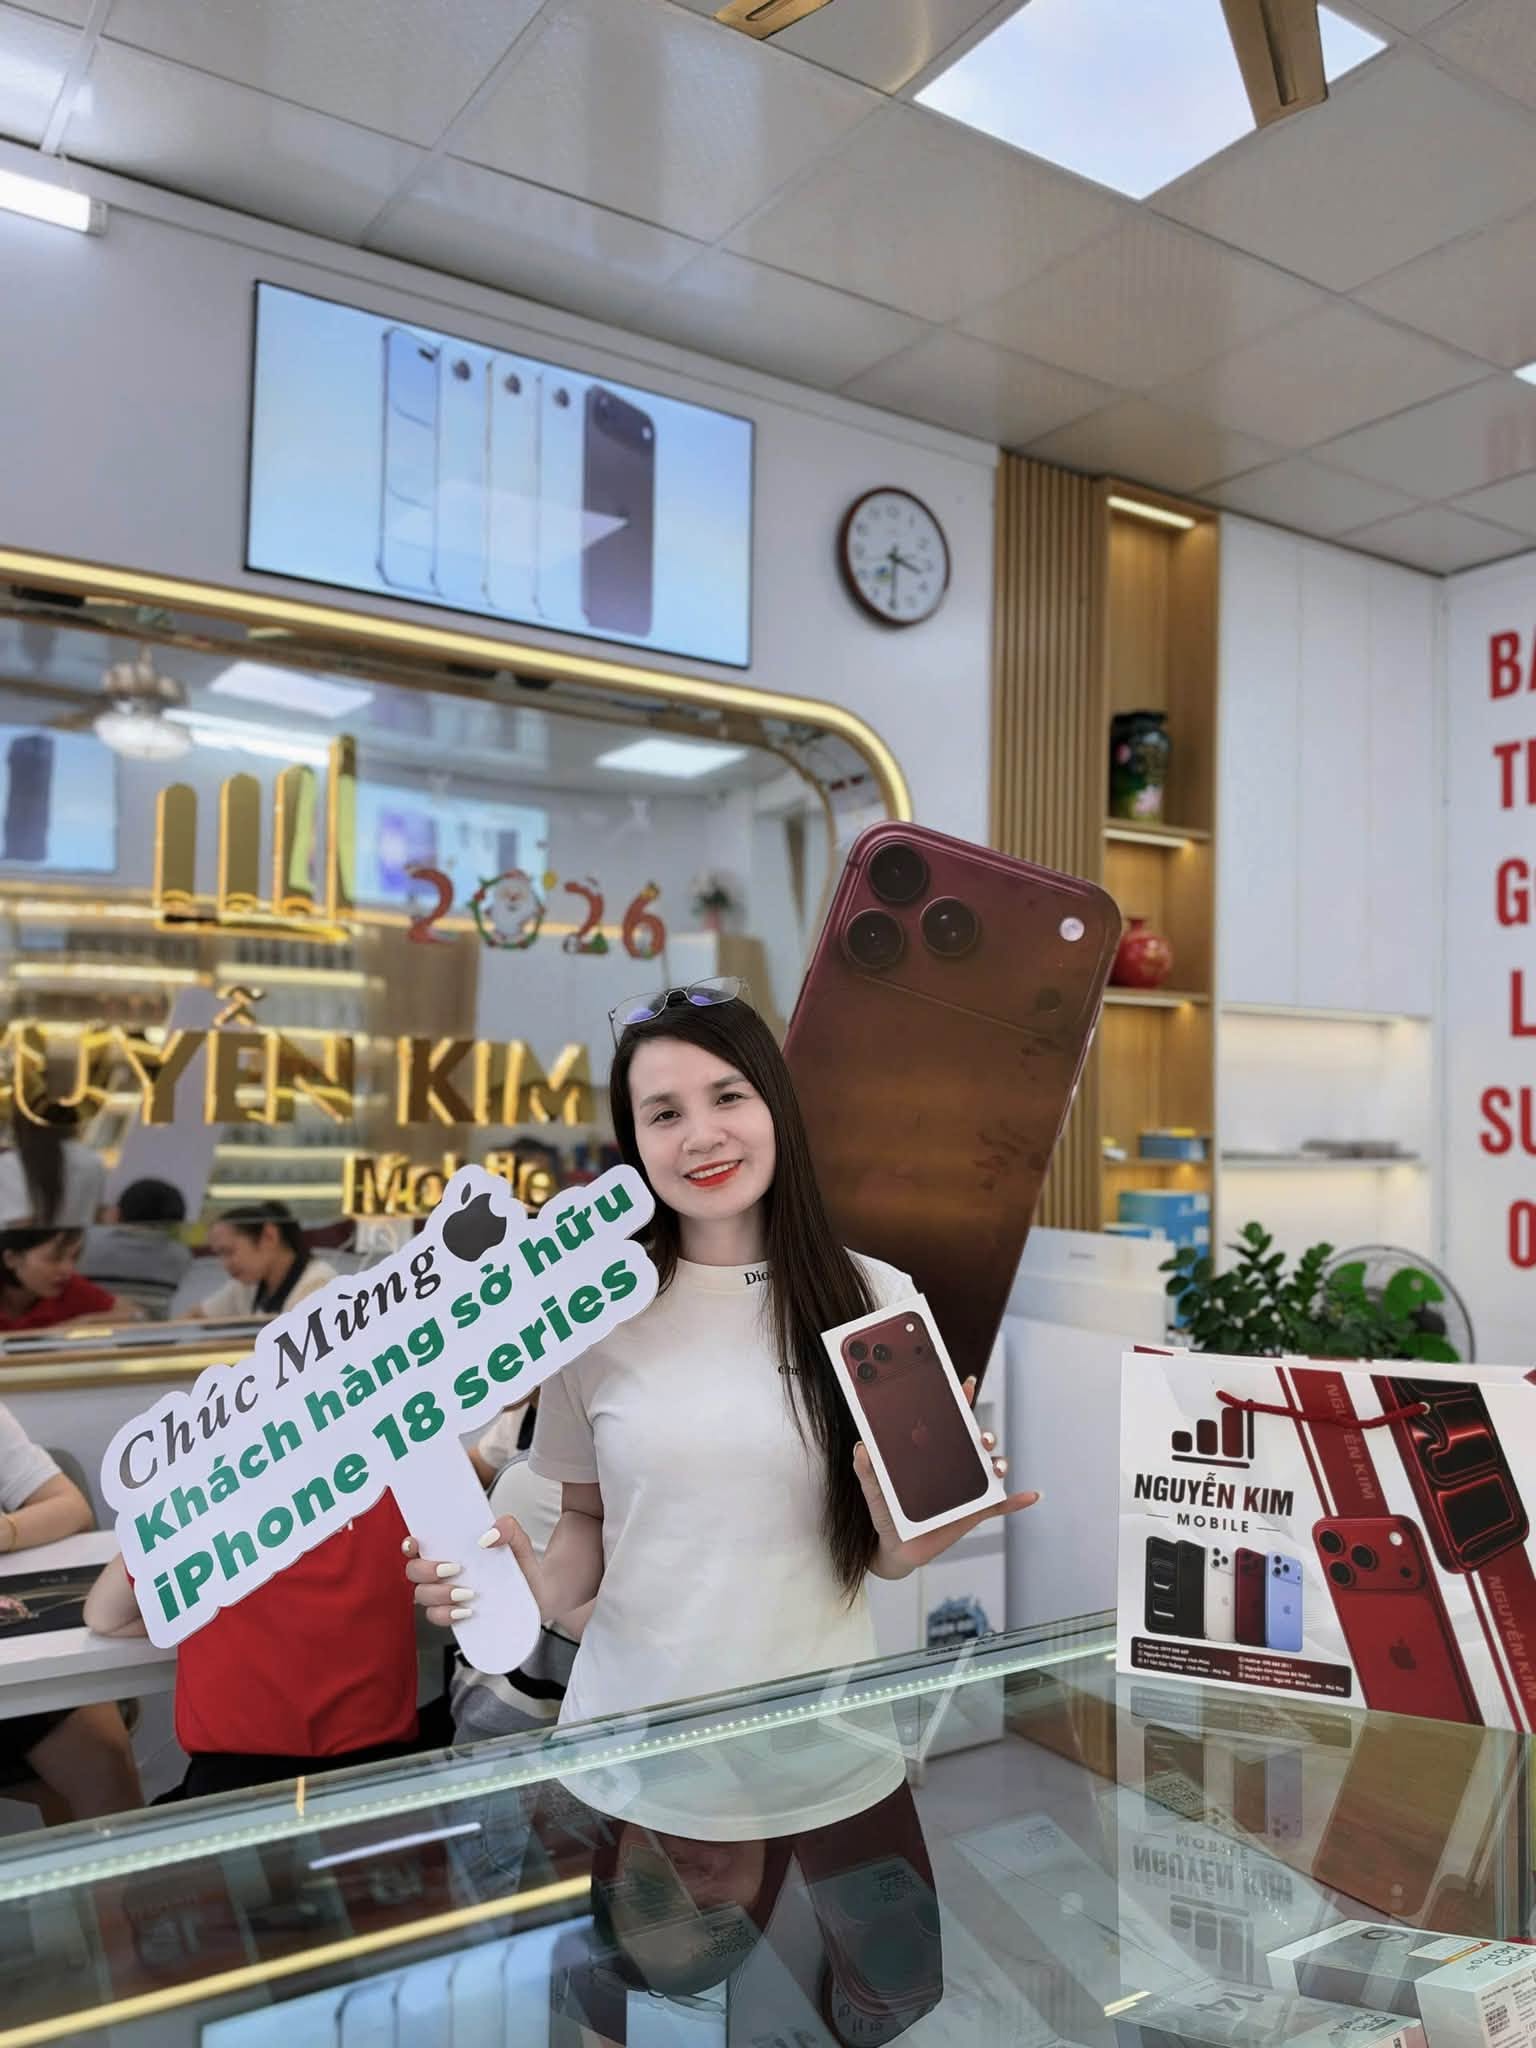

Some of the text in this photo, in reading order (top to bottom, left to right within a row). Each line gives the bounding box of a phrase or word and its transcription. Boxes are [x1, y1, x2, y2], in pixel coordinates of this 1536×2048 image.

[1490, 632, 1536, 699] B
[1497, 859, 1536, 926] G
[397, 1034, 592, 1126] KIM
[744, 1270, 771, 1286] Dio
[119, 1245, 442, 1490] Chúc Mừng
[135, 1183, 634, 1553] Khách hàng sở hữu
[154, 1259, 638, 1622] iPhone 18 series
[1134, 1471, 1294, 1517] NGUYỄN KIM
[1177, 1513, 1249, 1533] MOBILE
